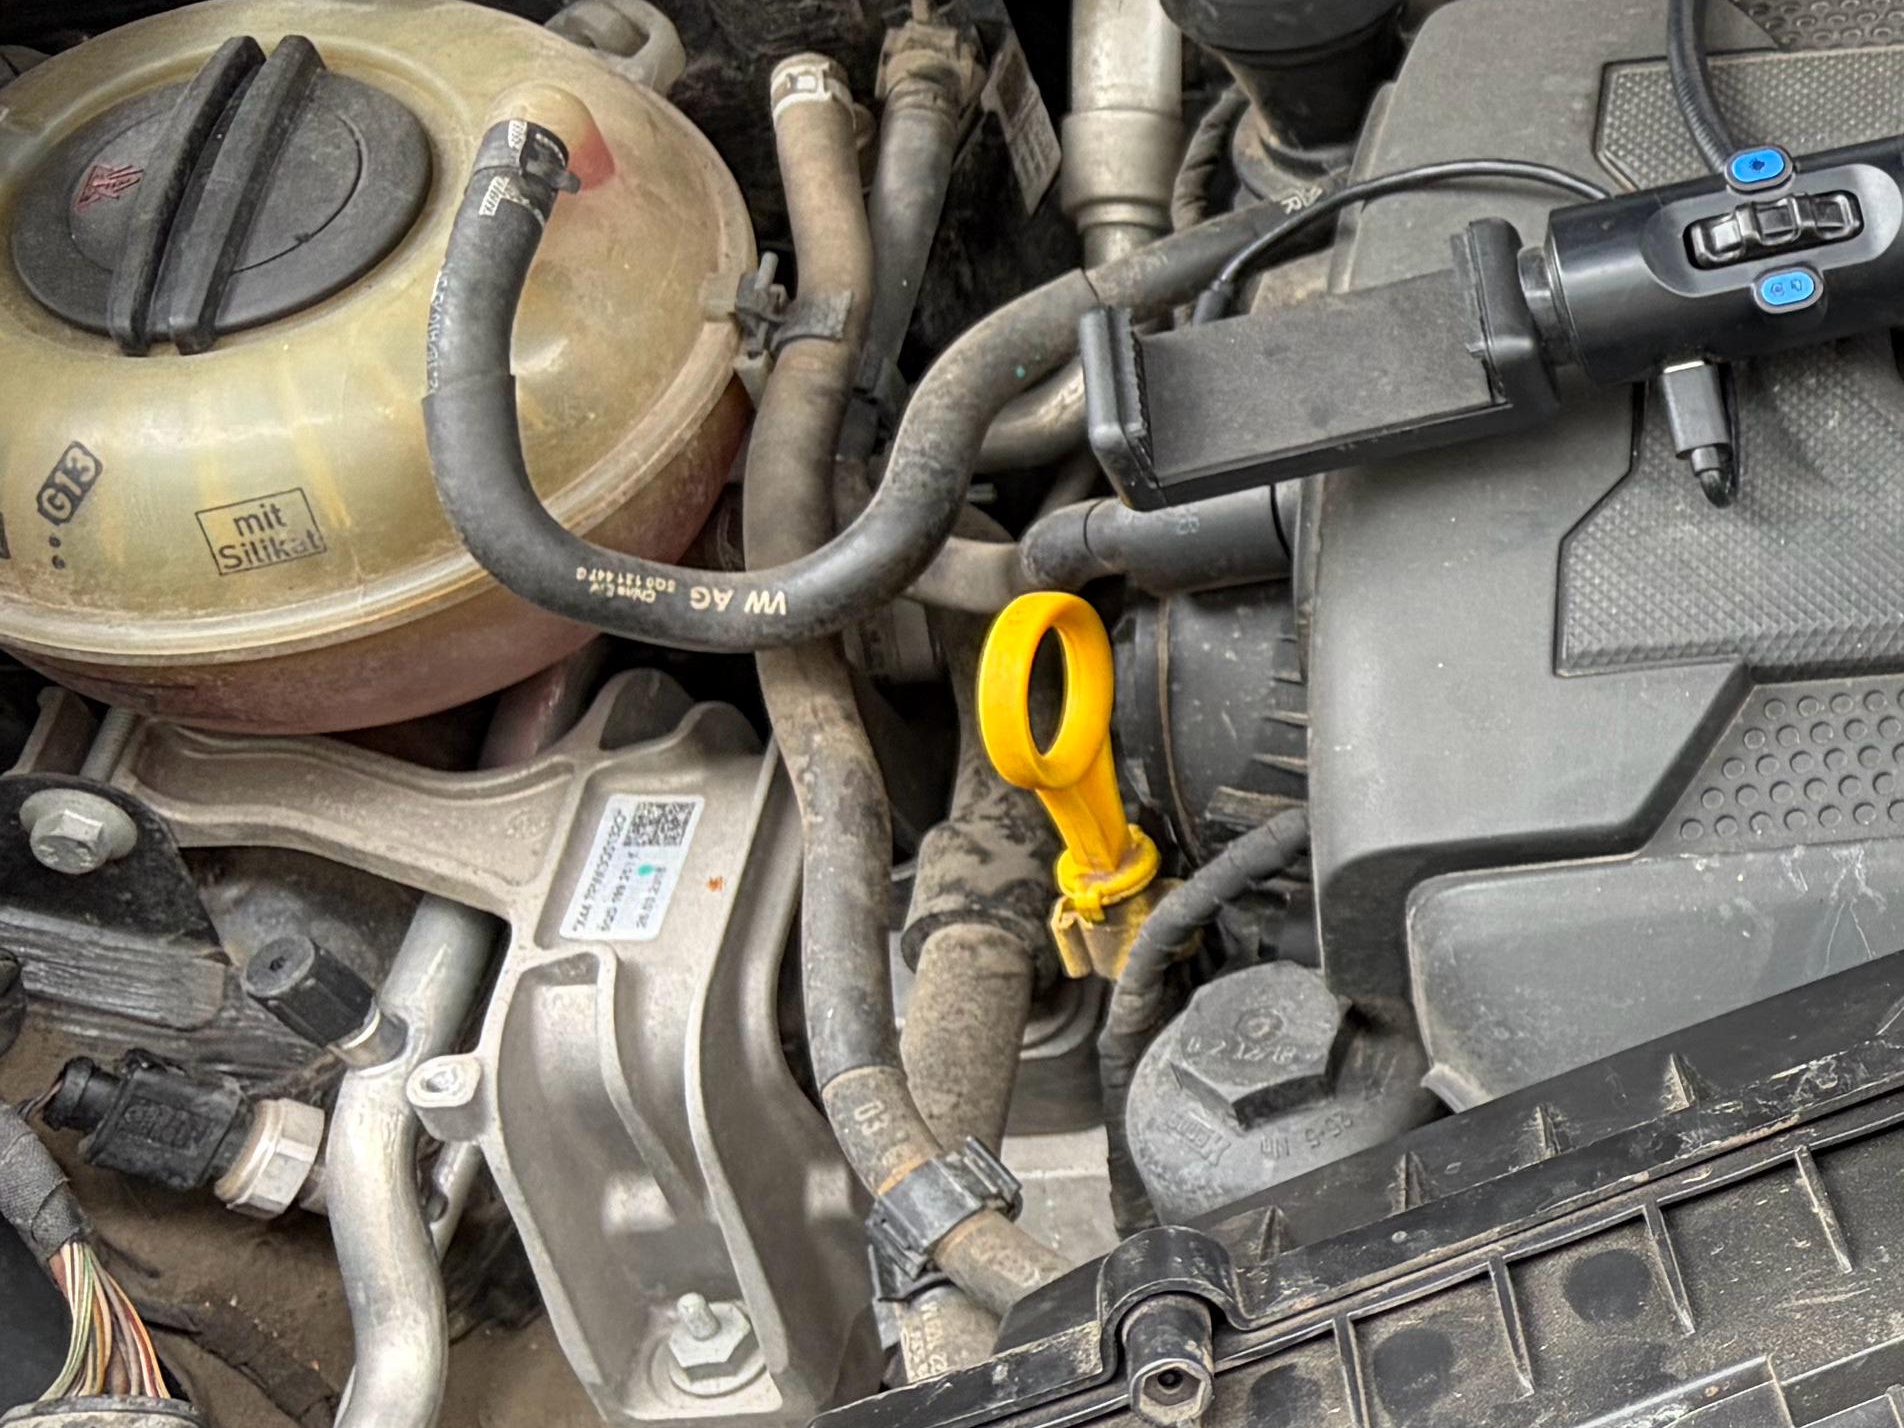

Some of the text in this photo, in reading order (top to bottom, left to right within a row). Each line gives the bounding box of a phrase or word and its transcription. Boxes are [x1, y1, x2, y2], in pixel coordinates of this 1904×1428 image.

[41, 448, 102, 522] G13
[232, 503, 287, 538] mit
[218, 529, 327, 570] Silikat
[689, 585, 787, 616] VW AG
